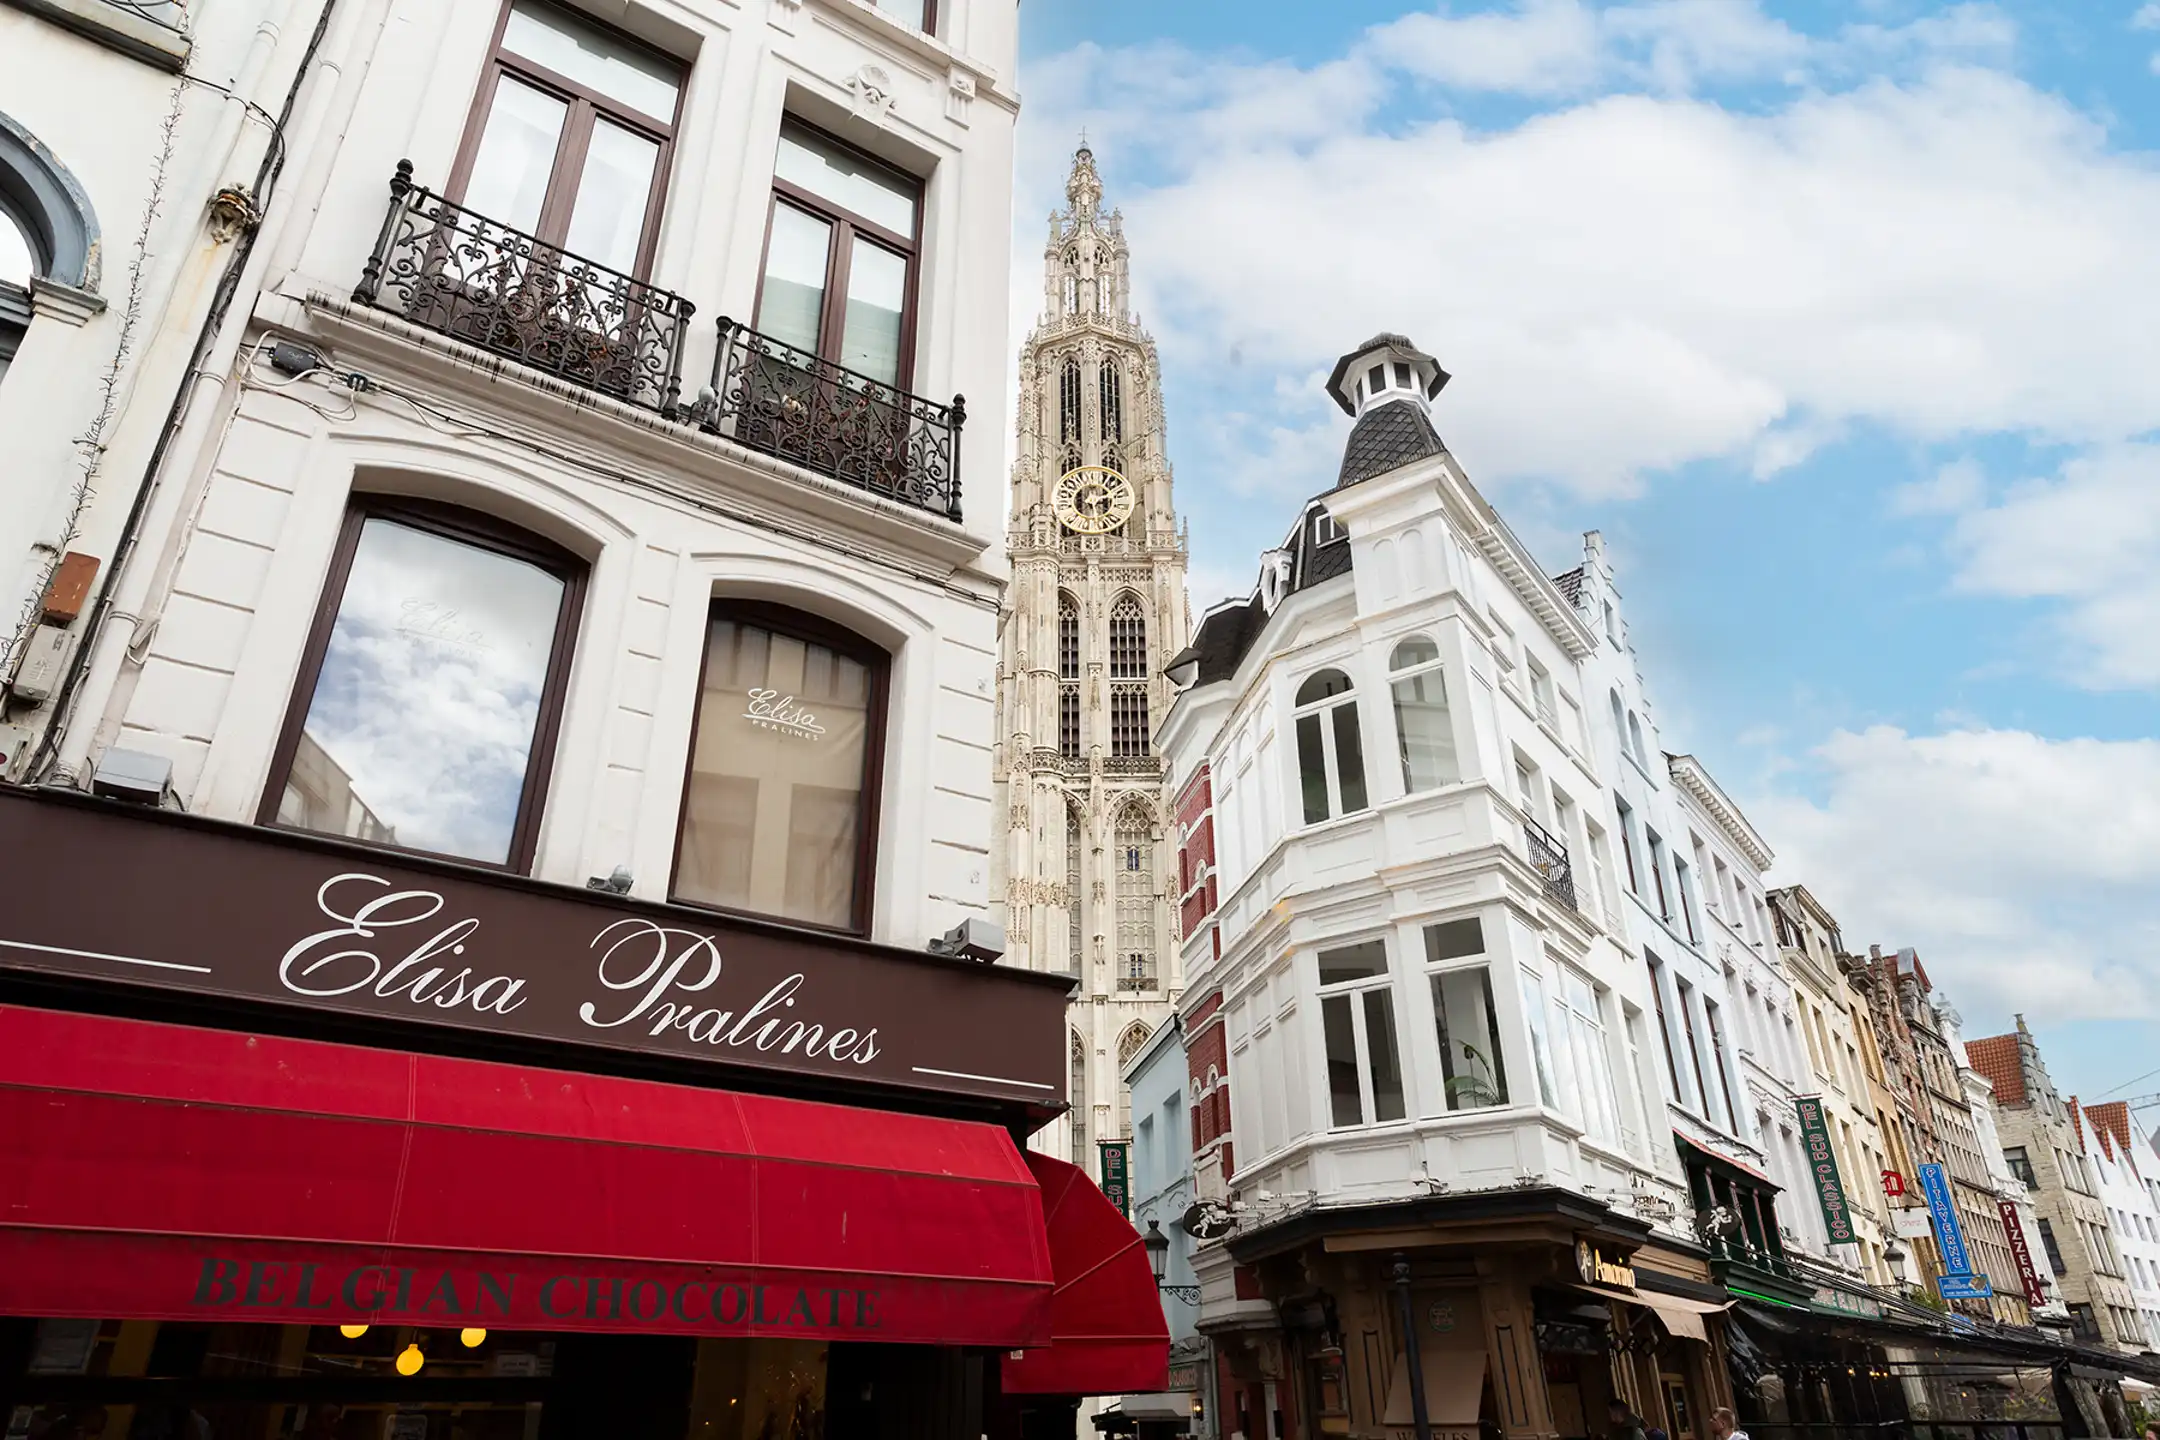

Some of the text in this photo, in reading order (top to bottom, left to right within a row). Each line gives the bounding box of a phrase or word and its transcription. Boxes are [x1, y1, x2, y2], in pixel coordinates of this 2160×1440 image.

[742, 688, 825, 734] Elisa
[752, 719, 819, 741] PRALINES
[279, 873, 882, 1064] Elisa Pralines
[1105, 1149, 1121, 1180] DEL
[1800, 1103, 1849, 1239] DEL SUD CLASSICO
[1926, 1168, 1963, 1268] PITAVERNE
[1595, 1248, 1636, 1288] Amorino
[2003, 1204, 2042, 1304] PIZZERIA
[193, 1258, 881, 1329] BELGIAN CHOCOLATE
